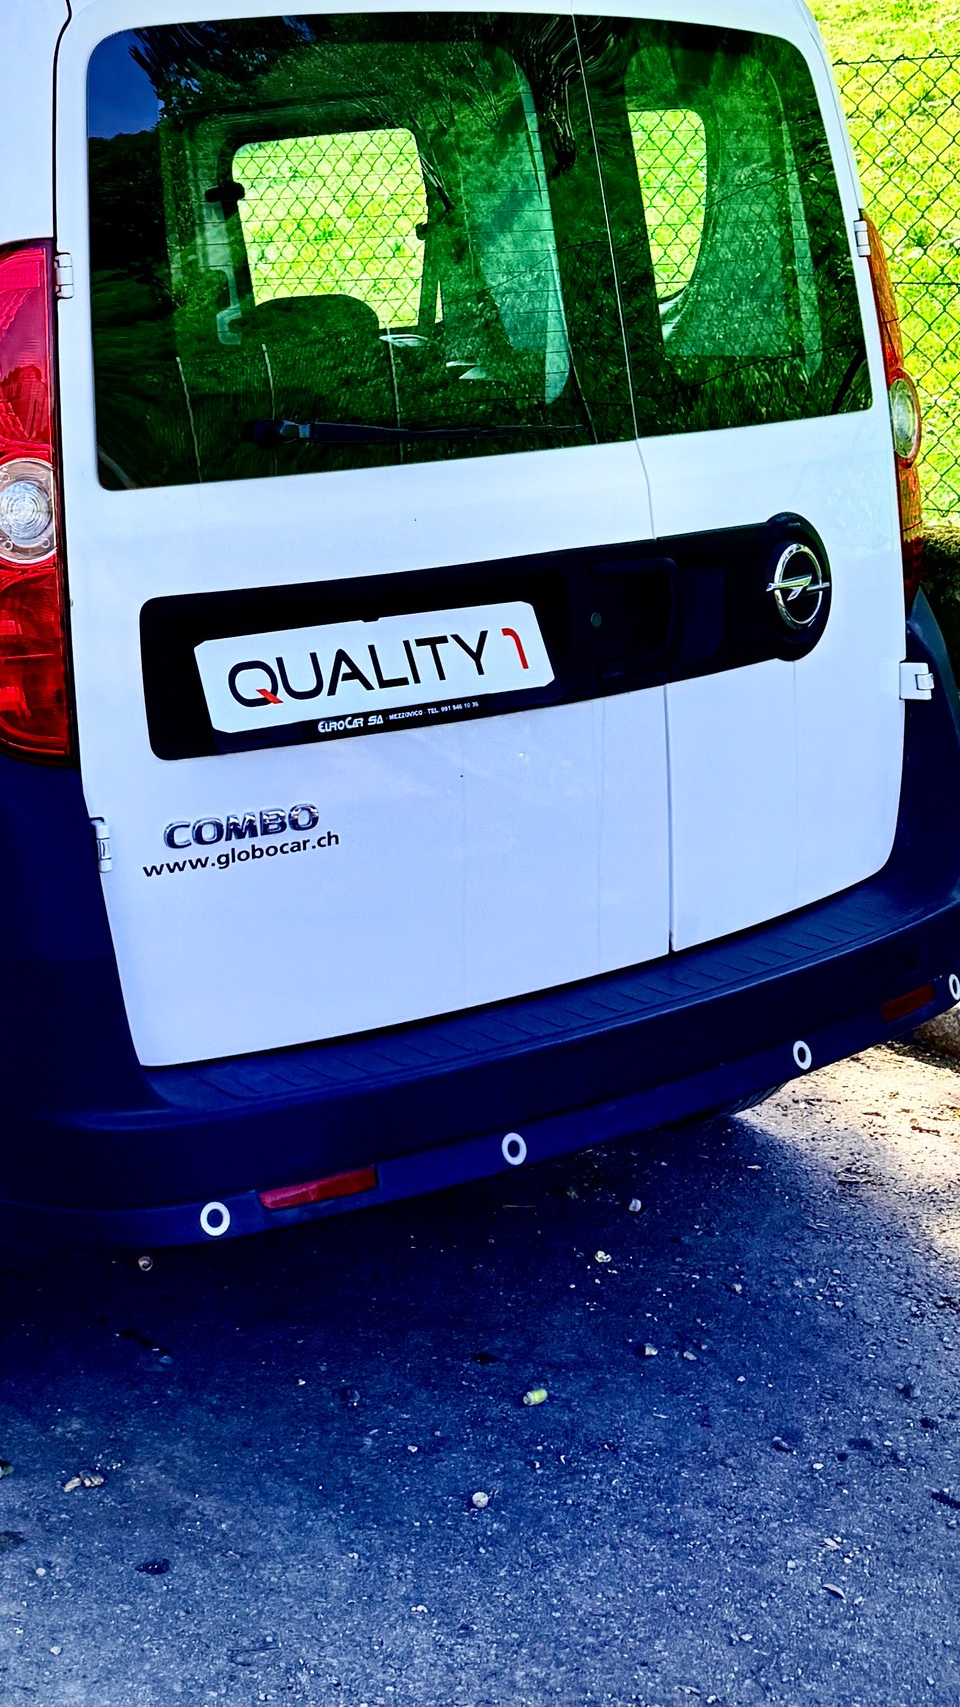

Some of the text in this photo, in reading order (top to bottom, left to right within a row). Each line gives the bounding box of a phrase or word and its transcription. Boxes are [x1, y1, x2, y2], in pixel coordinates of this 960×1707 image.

[228, 627, 529, 707] QUALITY 1
[368, 715, 384, 725] SA
[389, 710, 423, 720] MEZZOVICO
[163, 803, 320, 849] COMBO
[142, 831, 340, 878] www.globocar.ch
